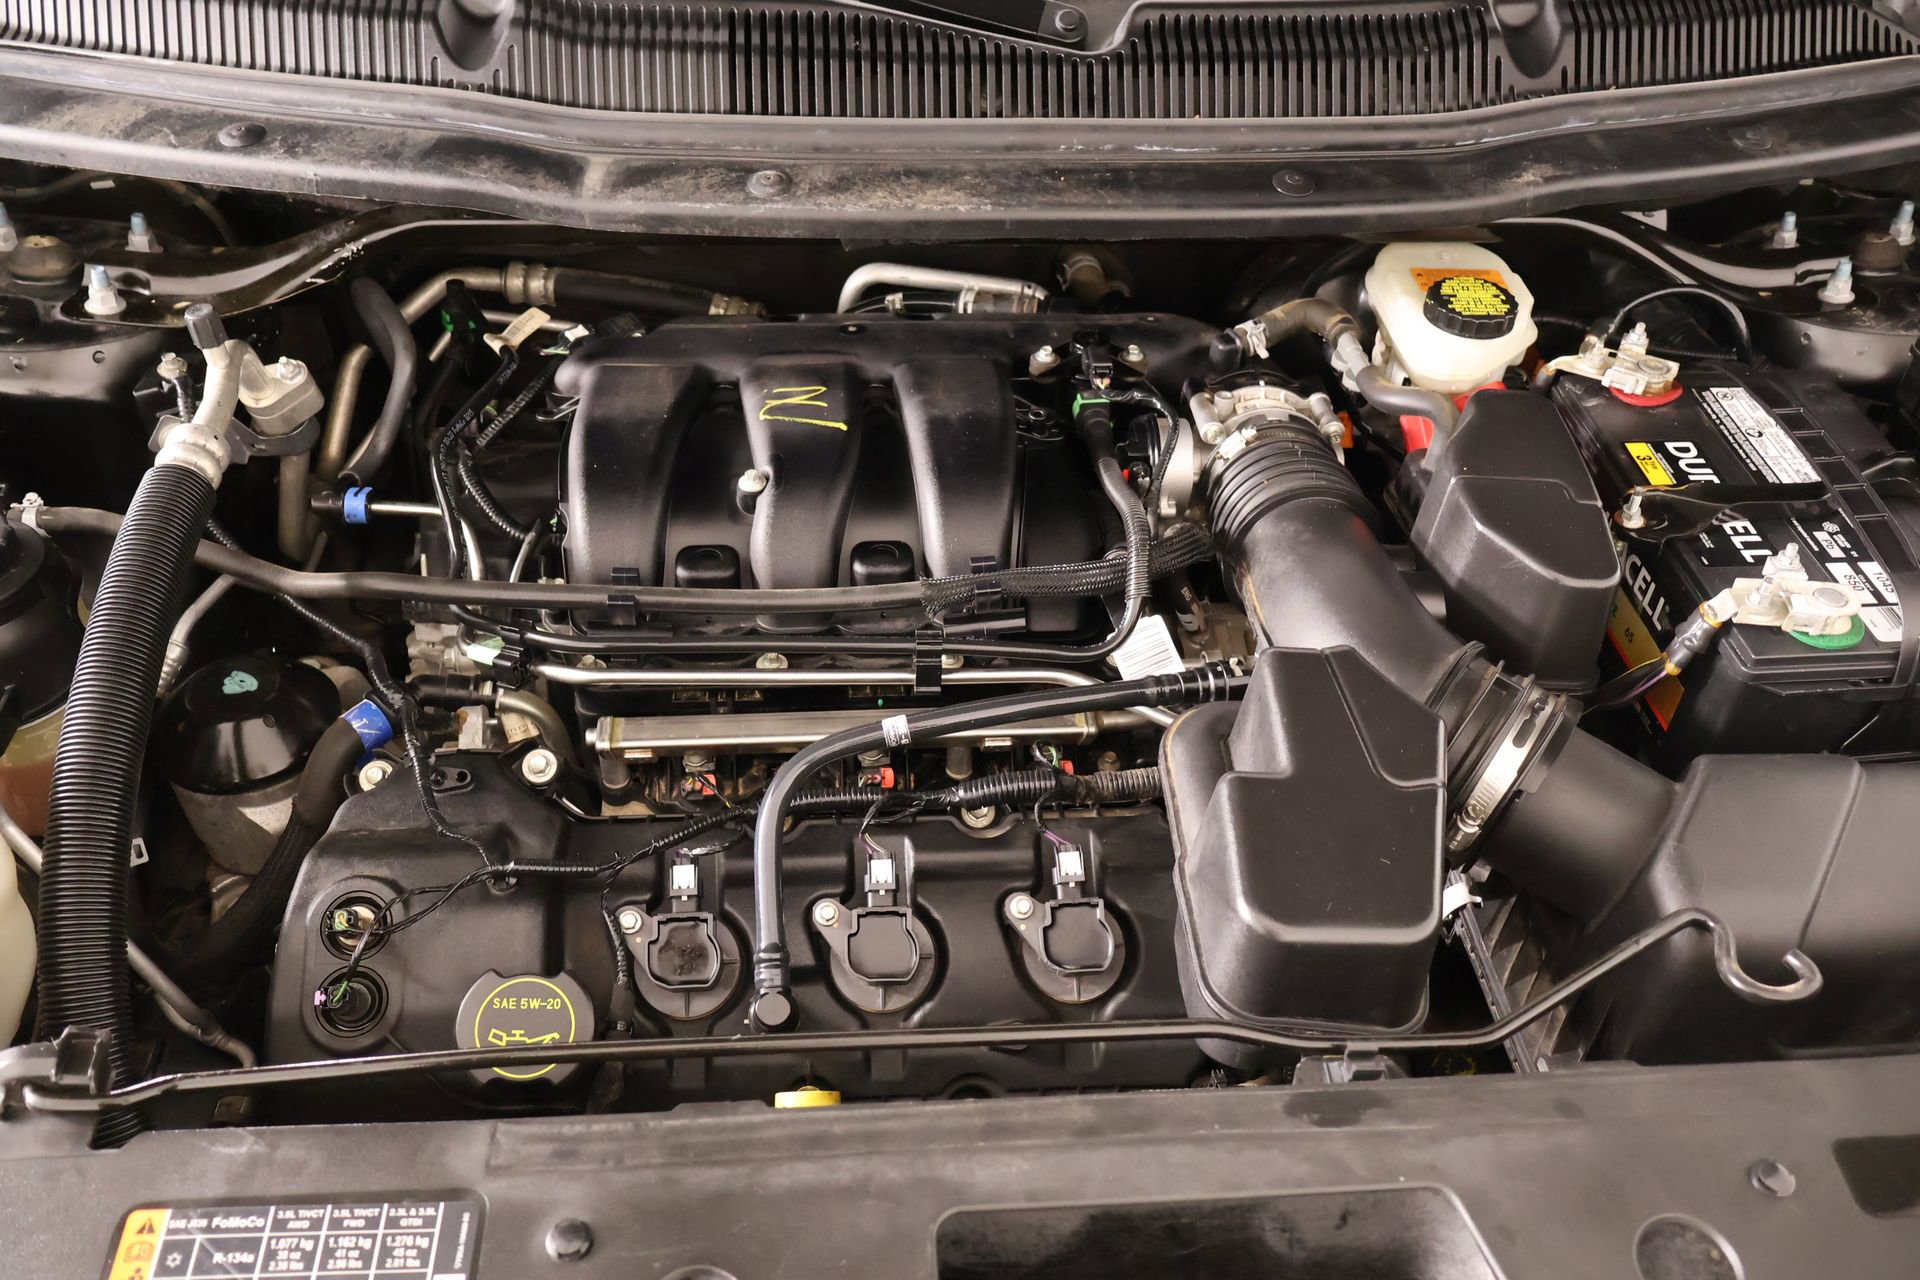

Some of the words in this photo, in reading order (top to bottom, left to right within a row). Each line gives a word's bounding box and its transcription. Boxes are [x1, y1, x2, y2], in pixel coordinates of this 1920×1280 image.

[1620, 548, 1665, 631] CELL
[1844, 574, 1864, 592] 850
[492, 997, 517, 1009] SAE
[520, 998, 561, 1010] 5W-20
[211, 1215, 265, 1229] FoMoCo
[299, 1238, 315, 1252] kg
[357, 1236, 373, 1250] kg
[414, 1235, 430, 1249] kg
[212, 1252, 255, 1265] R-134a
